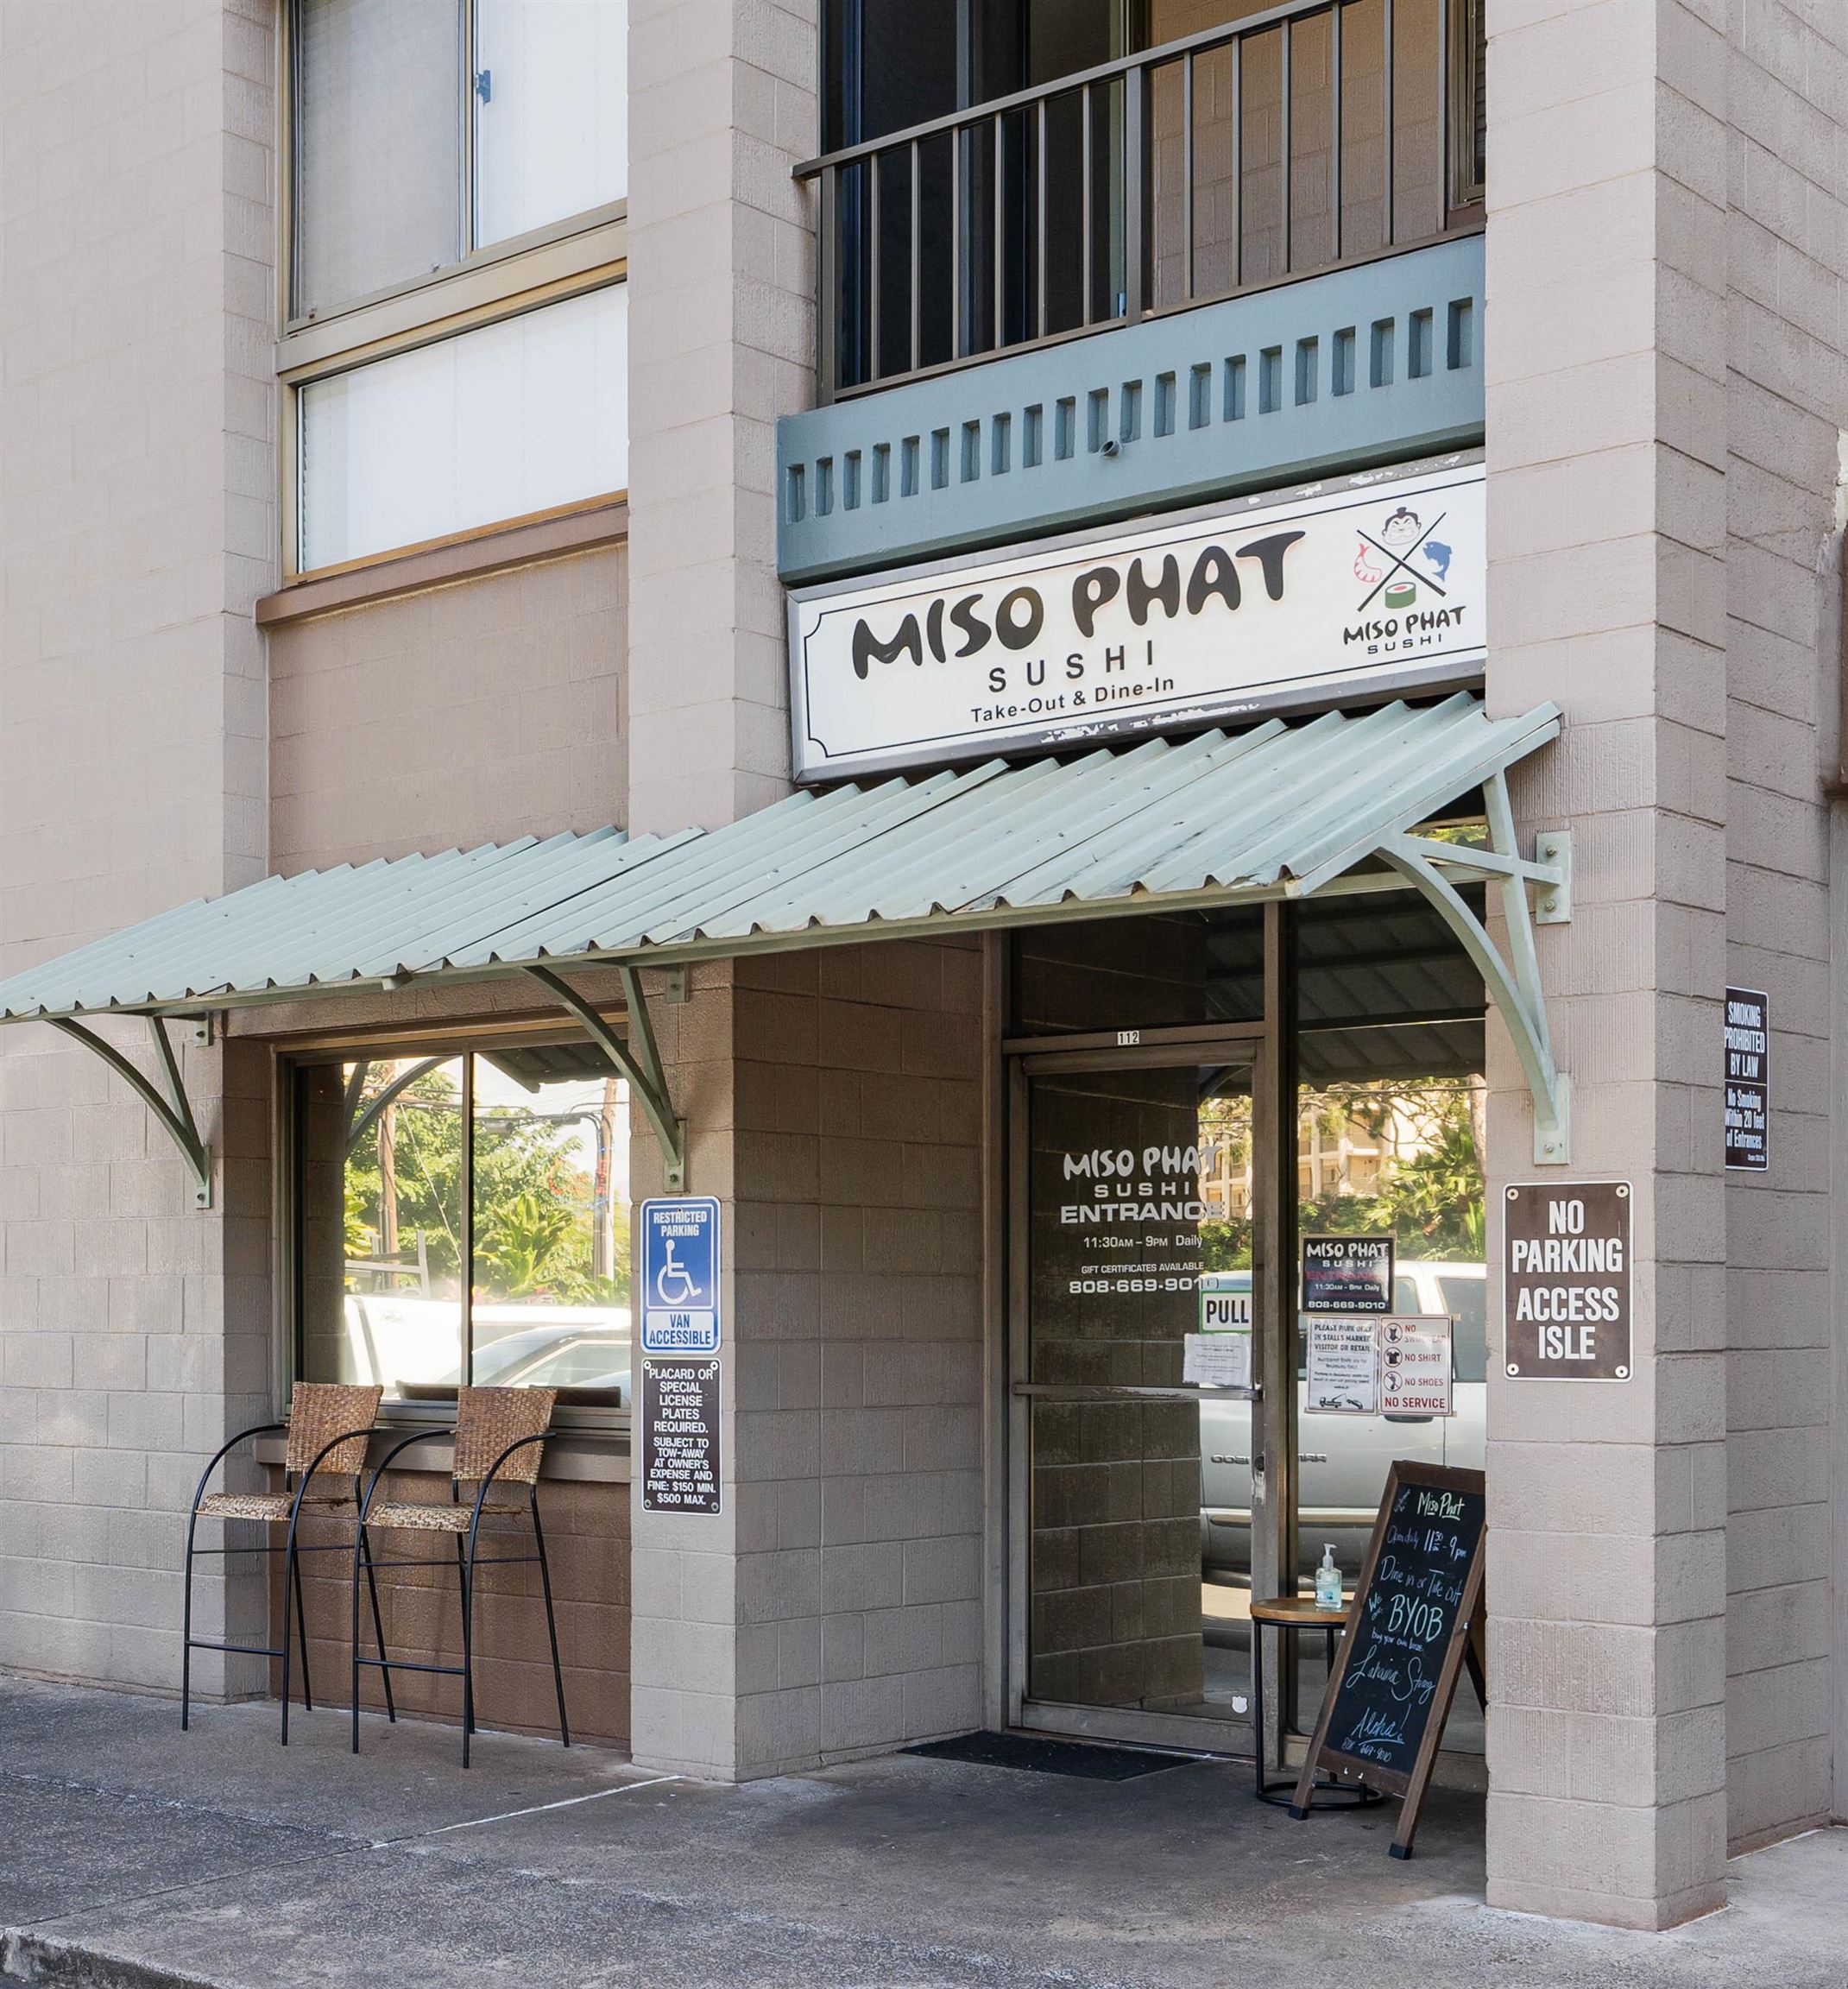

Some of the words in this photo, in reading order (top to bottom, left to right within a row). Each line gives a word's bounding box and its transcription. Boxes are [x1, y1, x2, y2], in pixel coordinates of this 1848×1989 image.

[852, 585, 1045, 680] MISO
[1071, 530, 1307, 639] PHAT
[1343, 619, 1398, 646] MISO
[1405, 605, 1466, 635] PHAT
[1367, 634, 1442, 654] SUSHI
[988, 640, 1152, 693] SUSHI
[971, 694, 1065, 723] Take-Out
[1073, 691, 1087, 707] &
[1095, 677, 1174, 703] Dine-In
[1728, 1001, 1761, 1028] SMOKING
[1120, 1032, 1138, 1044] 112
[1725, 1026, 1765, 1053] PROHIBITED
[1730, 1054, 1740, 1076] BY
[1742, 1055, 1759, 1078] LAW
[1063, 1149, 1134, 1181] MISO
[1143, 1146, 1221, 1177] PHAT
[1094, 1182, 1189, 1198] SUSHI
[653, 1210, 707, 1224] RESTRICTED
[1061, 1201, 1226, 1224] ENTRANCE
[1549, 1200, 1584, 1234] NO
[661, 1224, 699, 1237] PARKING
[1083, 1236, 1133, 1248] 11:30AM
[1145, 1236, 1168, 1247] 9PM
[1176, 1234, 1202, 1248] Daily
[1306, 1243, 1344, 1258] MISO
[1348, 1242, 1389, 1257] PHAT
[1512, 1238, 1623, 1272] PARKING
[1081, 1265, 1099, 1274] GIFT
[1101, 1264, 1157, 1273] CERTIFICATES
[1158, 1261, 1204, 1272] AVAILABLE
[1206, 1300, 1249, 1324] PULL
[1516, 1287, 1619, 1322] ACCESS
[670, 1314, 690, 1328] VAN
[649, 1329, 711, 1345] ACCESSIBLE
[1539, 1326, 1596, 1361] ISLE
[1418, 1354, 1441, 1362] SHIRT
[649, 1367, 695, 1380] PLACARD
[697, 1369, 713, 1380] OR
[659, 1381, 703, 1393] SPECIAL
[1418, 1378, 1443, 1386] SHOES
[659, 1395, 703, 1406] LICENSE
[1385, 1397, 1398, 1407] NO
[1403, 1398, 1445, 1408] SERVICE
[662, 1408, 700, 1419] PLATES
[653, 1421, 709, 1433] REQUIRED.
[653, 1436, 693, 1448] SUBJECT
[697, 1437, 709, 1449] TO
[657, 1448, 705, 1459] TOW-AWAY
[653, 1457, 665, 1468] AT
[667, 1459, 710, 1470] OWNER'S
[650, 1468, 690, 1480] EXPENSE
[693, 1470, 713, 1481] AND
[647, 1481, 669, 1491] FINE:
[672, 1481, 694, 1493] $150
[697, 1482, 716, 1493] MIN.
[657, 1493, 681, 1505] $500
[684, 1494, 706, 1506] MAX.
[1417, 1492, 1438, 1516] Miso
[1439, 1492, 1466, 1518] Phat
[1380, 1556, 1403, 1583] Dine
[1405, 1566, 1415, 1587] in
[1416, 1577, 1428, 1588] or
[1388, 1594, 1443, 1643] BYOB
